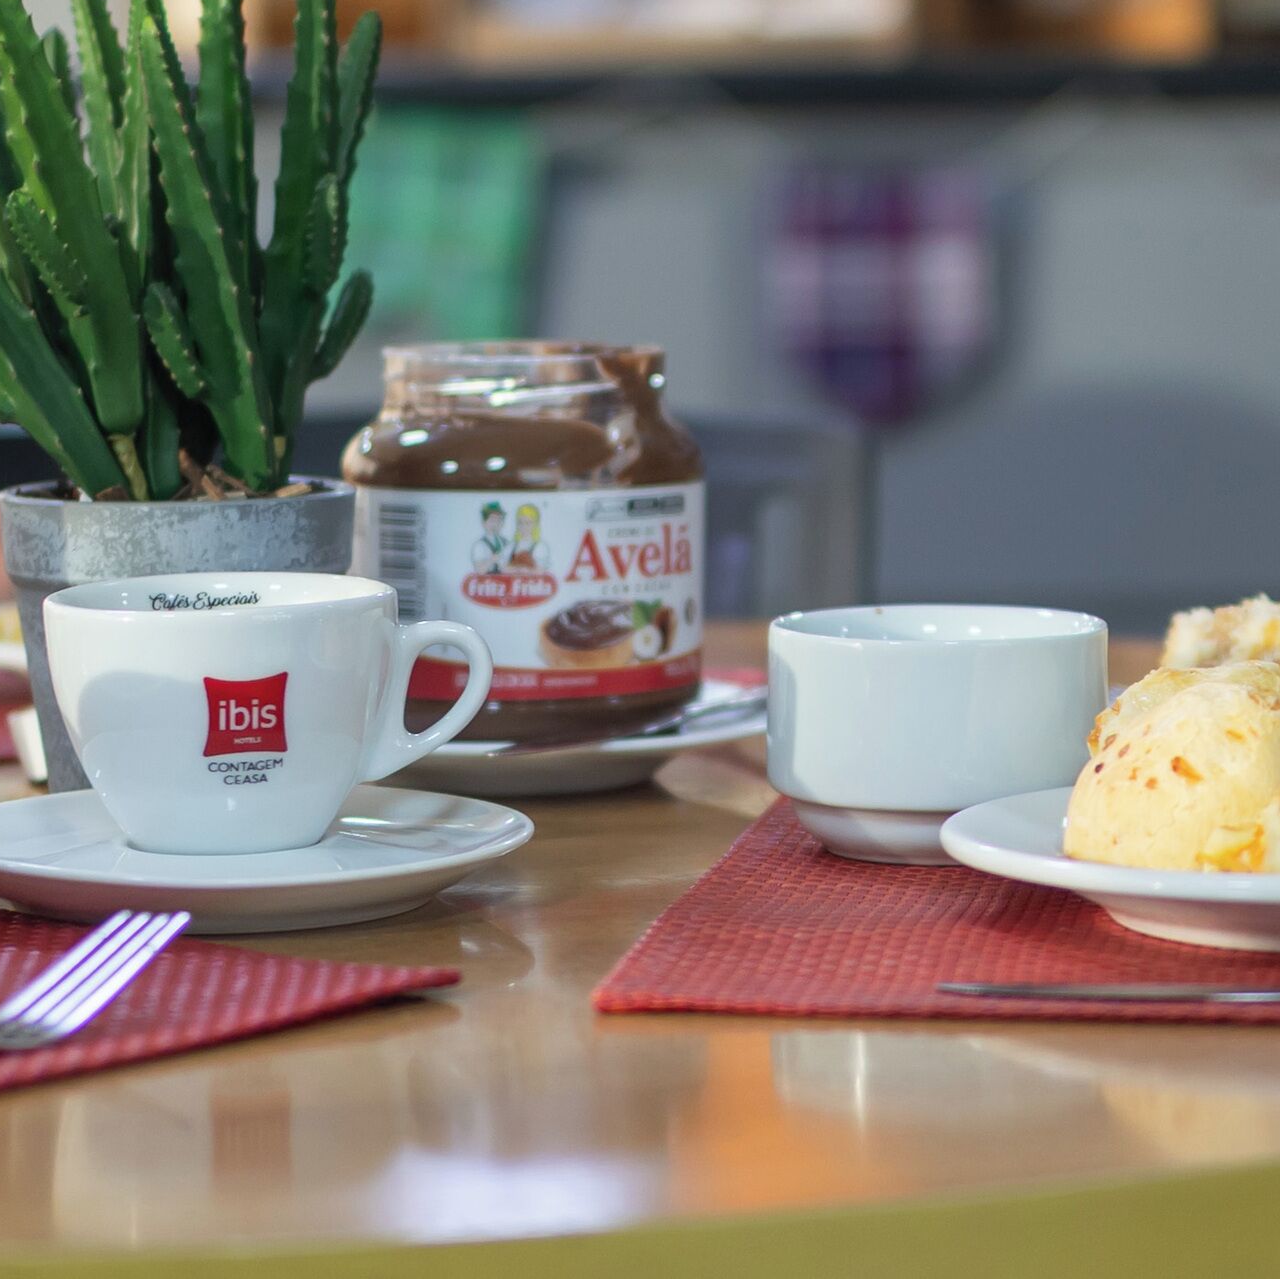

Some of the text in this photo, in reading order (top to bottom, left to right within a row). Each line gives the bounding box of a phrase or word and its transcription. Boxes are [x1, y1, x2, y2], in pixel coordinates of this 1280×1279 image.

[149, 591, 260, 611] Cafés Especiais
[219, 699, 277, 731] ibis
[233, 736, 262, 744] HOTELS
[208, 758, 283, 773] CONTAGEM
[223, 773, 268, 785] CEASA
